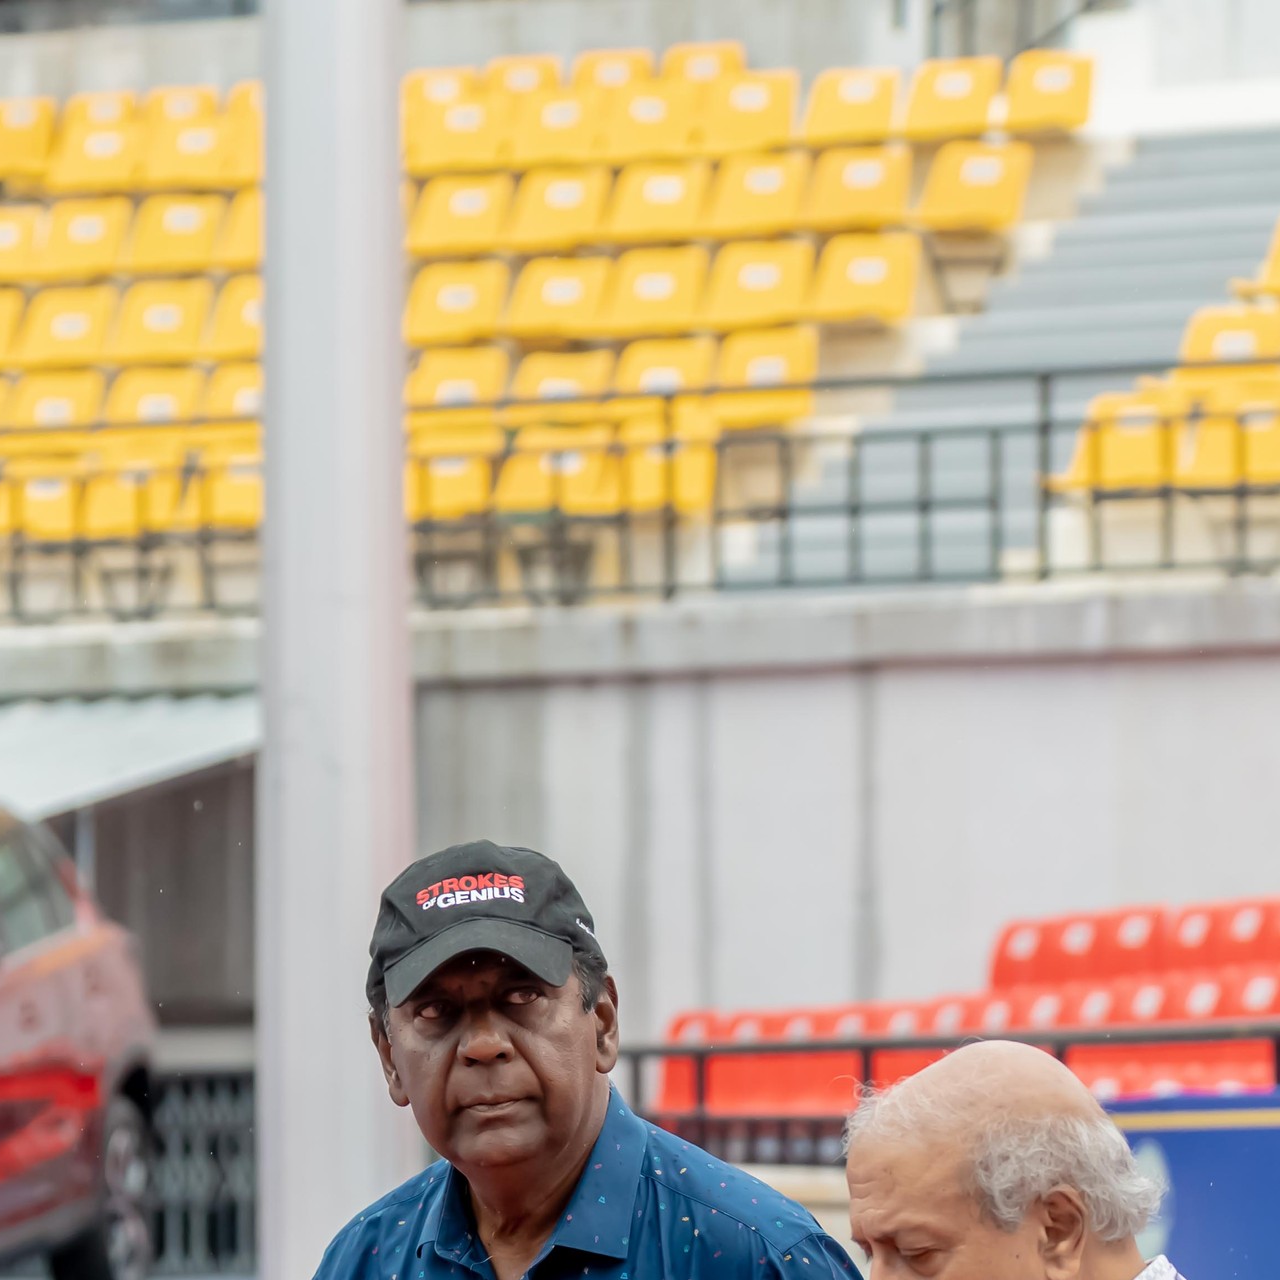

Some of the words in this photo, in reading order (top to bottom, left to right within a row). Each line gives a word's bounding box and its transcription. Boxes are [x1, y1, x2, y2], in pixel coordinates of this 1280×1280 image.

[416, 872, 525, 906] STROKES
[422, 896, 438, 910] OF
[437, 886, 525, 909] GENIUS
